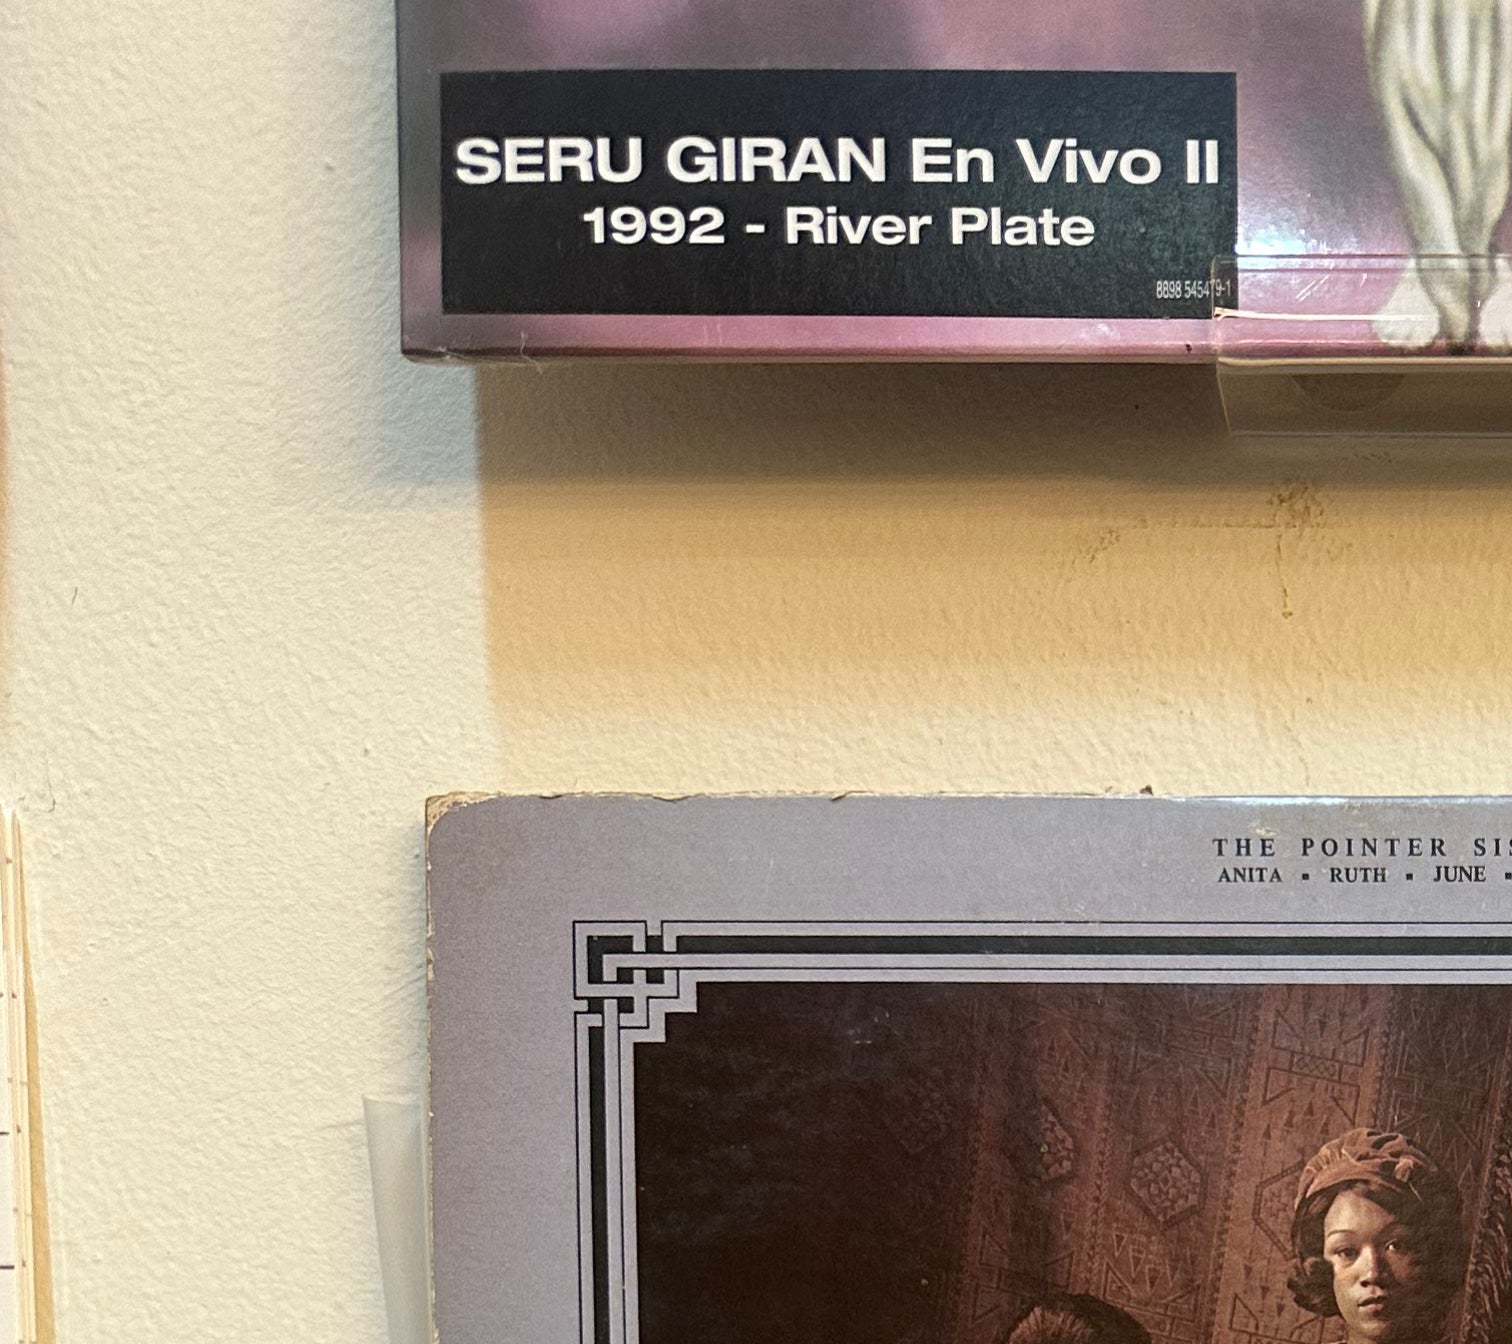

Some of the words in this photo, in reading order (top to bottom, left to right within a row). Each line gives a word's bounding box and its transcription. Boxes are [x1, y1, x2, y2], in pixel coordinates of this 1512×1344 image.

[456, 138, 641, 184] SERU
[667, 136, 885, 182] GIRAN
[912, 138, 994, 182] En
[1016, 138, 1161, 184] Vivo
[1186, 140, 1218, 183] II
[583, 207, 724, 244] 1992
[746, 224, 764, 233] -
[787, 206, 932, 245] River
[952, 207, 1094, 246] Plate
[1156, 280, 1182, 299] 8898
[1212, 838, 1275, 856] THE
[1302, 838, 1446, 857] POINTER
[1218, 867, 1282, 883] ANITA
[1330, 867, 1386, 883] RUTH
[1433, 866, 1486, 882] JUNE
